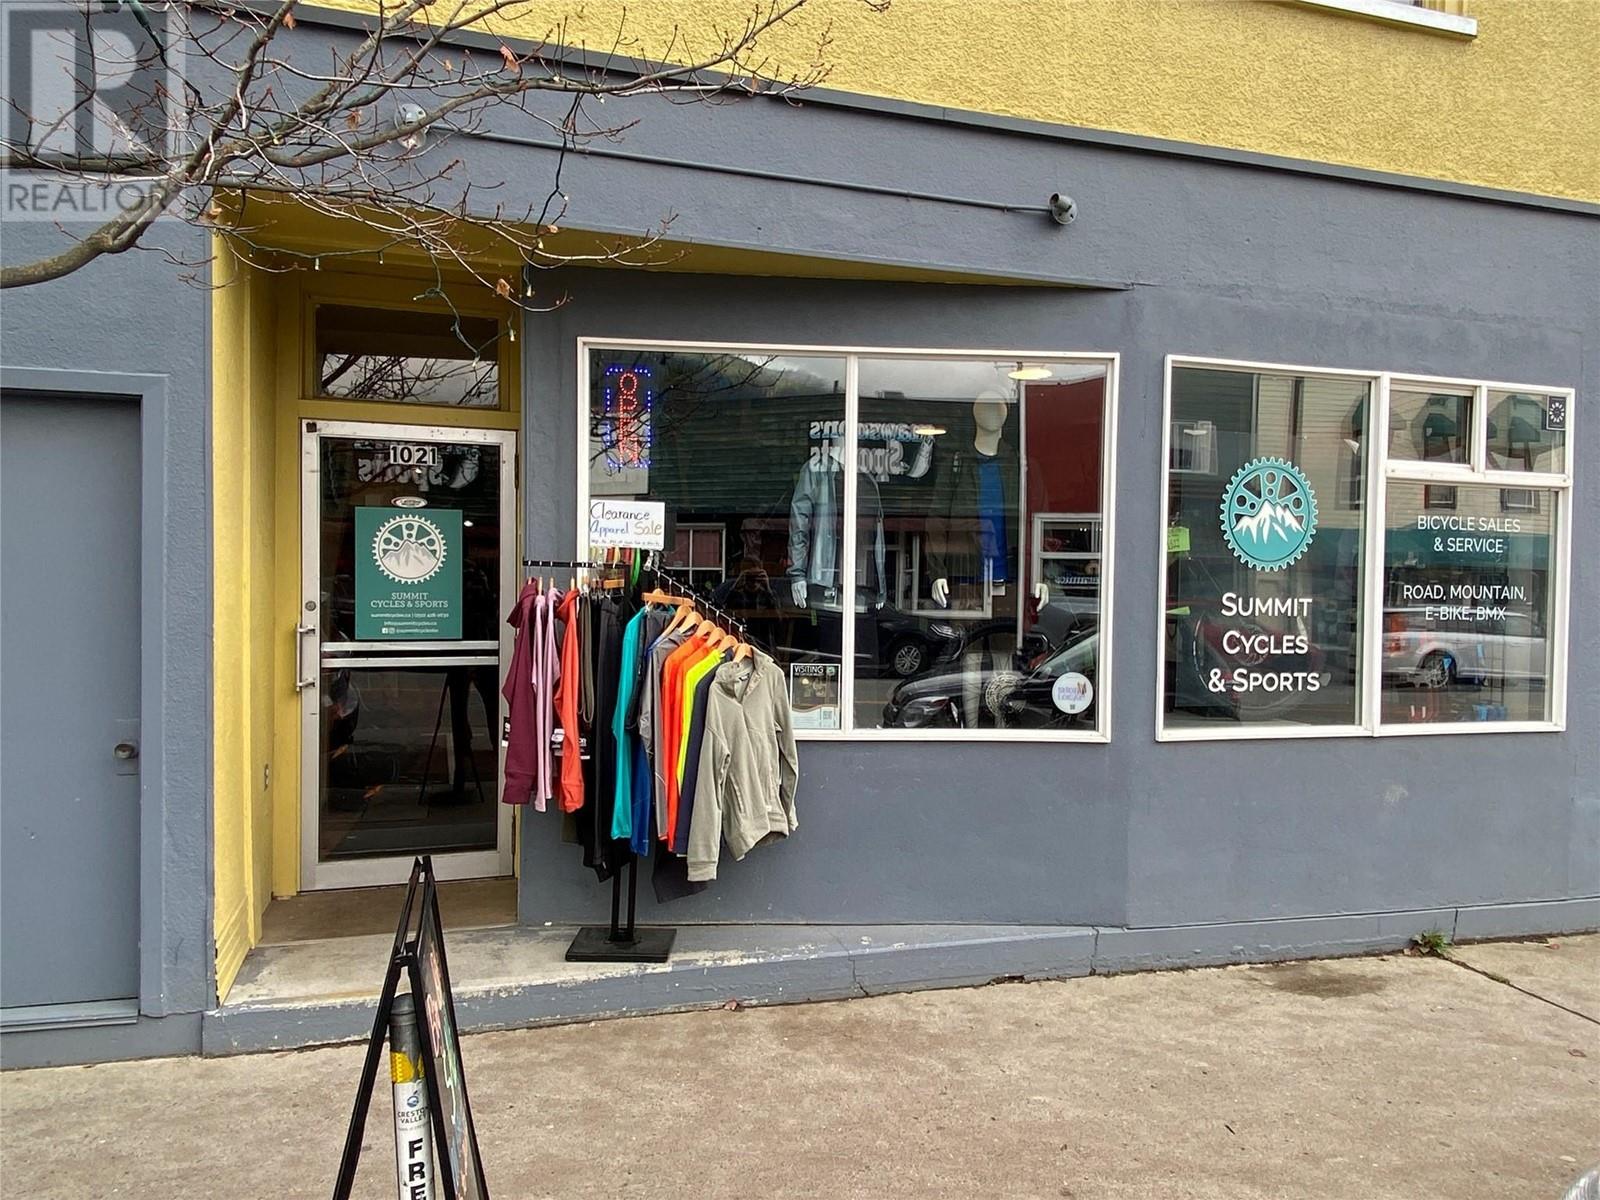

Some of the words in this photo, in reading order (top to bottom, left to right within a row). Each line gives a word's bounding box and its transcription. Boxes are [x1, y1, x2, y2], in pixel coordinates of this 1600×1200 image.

[390, 446, 437, 465] 1021
[590, 501, 650, 520] Clearance
[633, 521, 662, 536] Sale
[1417, 515, 1475, 531] BICYCLE
[1478, 517, 1521, 533] SALES
[1433, 537, 1444, 552] &
[1447, 537, 1504, 553] SERVICE
[392, 592, 429, 600] SUMMIT
[1403, 584, 1446, 600] ROAD,
[1450, 585, 1527, 601] MOUNTAIN,
[371, 600, 405, 608] CYCLES
[407, 600, 413, 608] &
[414, 600, 449, 608] SPORTS
[1425, 607, 1473, 622] E-BIKE,
[1476, 607, 1506, 621] BMX
[794, 665, 824, 674] VISITING
[1208, 668, 1226, 692] &
